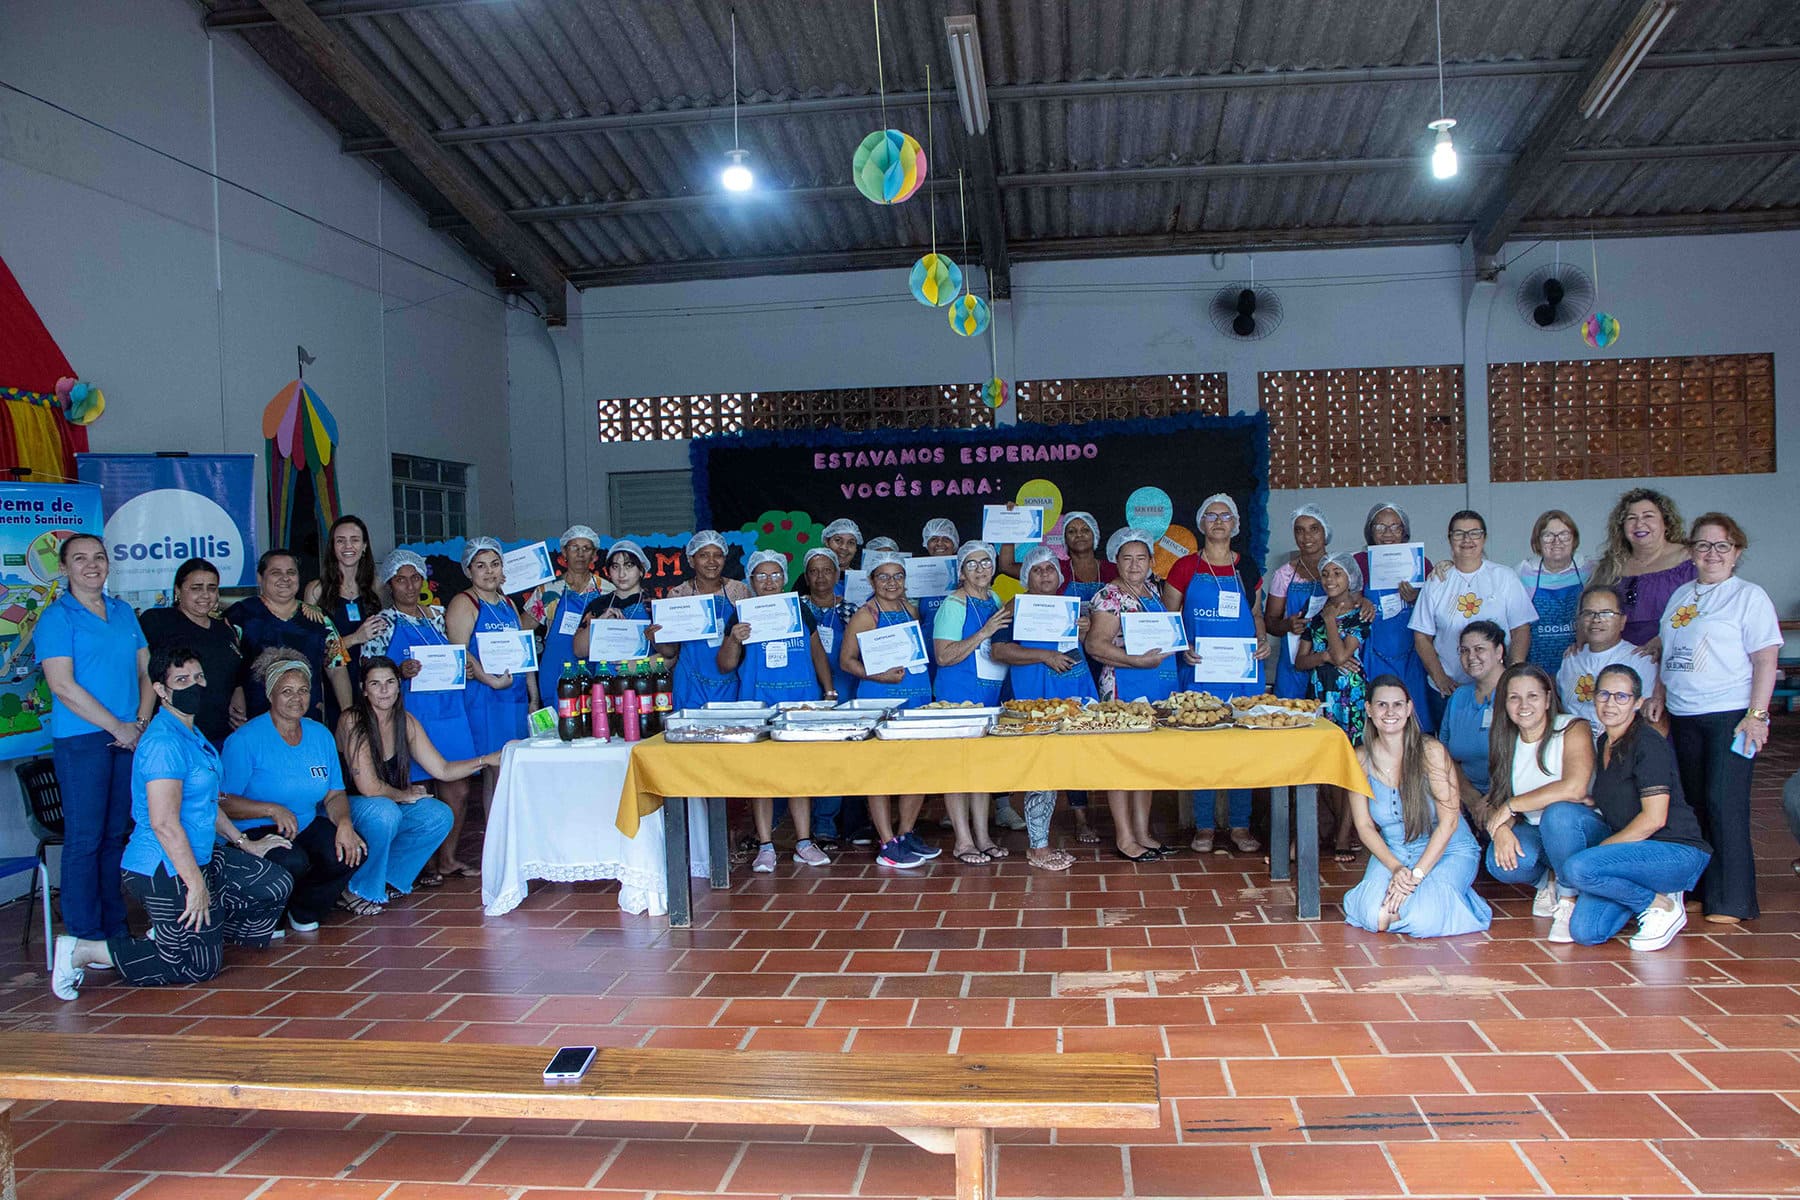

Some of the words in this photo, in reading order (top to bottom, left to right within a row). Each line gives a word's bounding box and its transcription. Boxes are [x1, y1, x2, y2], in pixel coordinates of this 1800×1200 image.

[813, 447, 945, 469] ESTAVAMOS
[960, 443, 1098, 464] ESPERANDO
[840, 473, 922, 499] VOCÊS
[931, 477, 1001, 496] PARA:
[51, 497, 74, 512] de
[34, 514, 83, 525] Sanitario
[113, 535, 231, 561] sociallis
